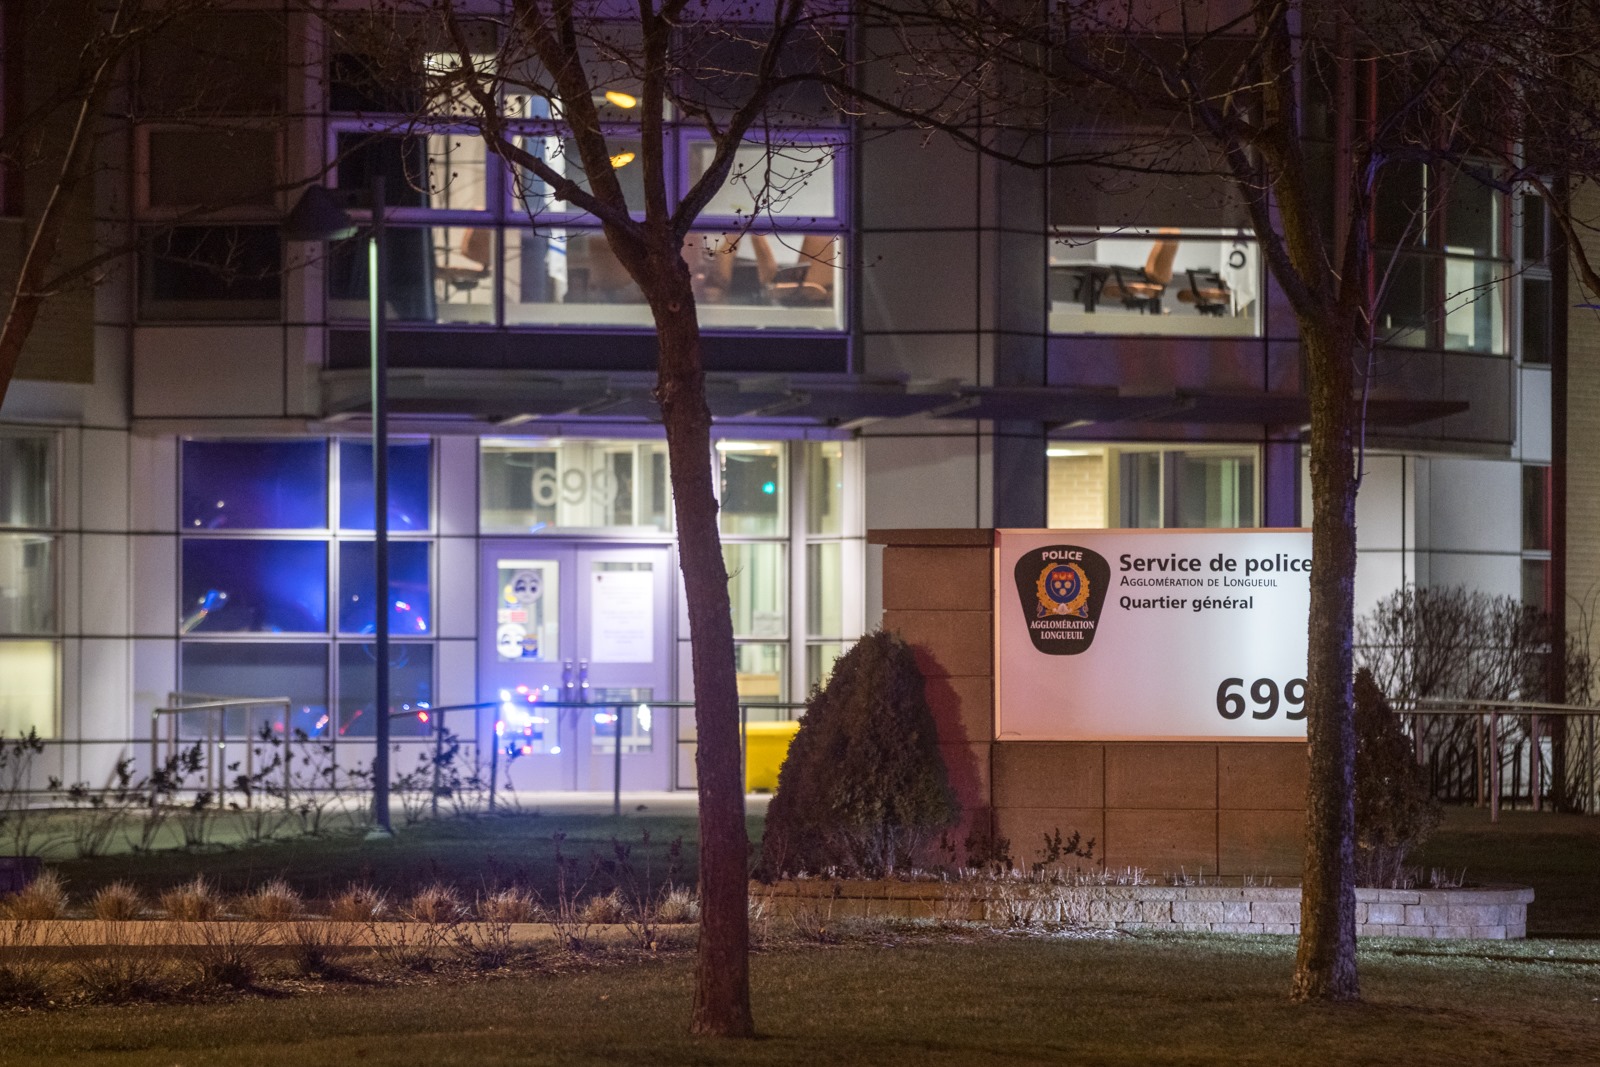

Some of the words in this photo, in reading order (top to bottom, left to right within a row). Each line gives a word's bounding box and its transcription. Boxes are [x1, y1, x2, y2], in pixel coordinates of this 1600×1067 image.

[532, 467, 618, 506] 699
[1042, 550, 1083, 561] POLICE
[1119, 553, 1201, 572] Service
[1209, 553, 1237, 572] de
[1245, 553, 1313, 576] police
[1120, 575, 1203, 587] AGGLOMÉRATION
[1223, 576, 1277, 587] LONGUEUIL
[1119, 596, 1187, 611] Quartier
[1192, 595, 1253, 612] général
[1030, 619, 1095, 629] AGGLOMÉRATION
[1041, 631, 1084, 639] LONGUEUIL
[1216, 677, 1309, 721] 699
